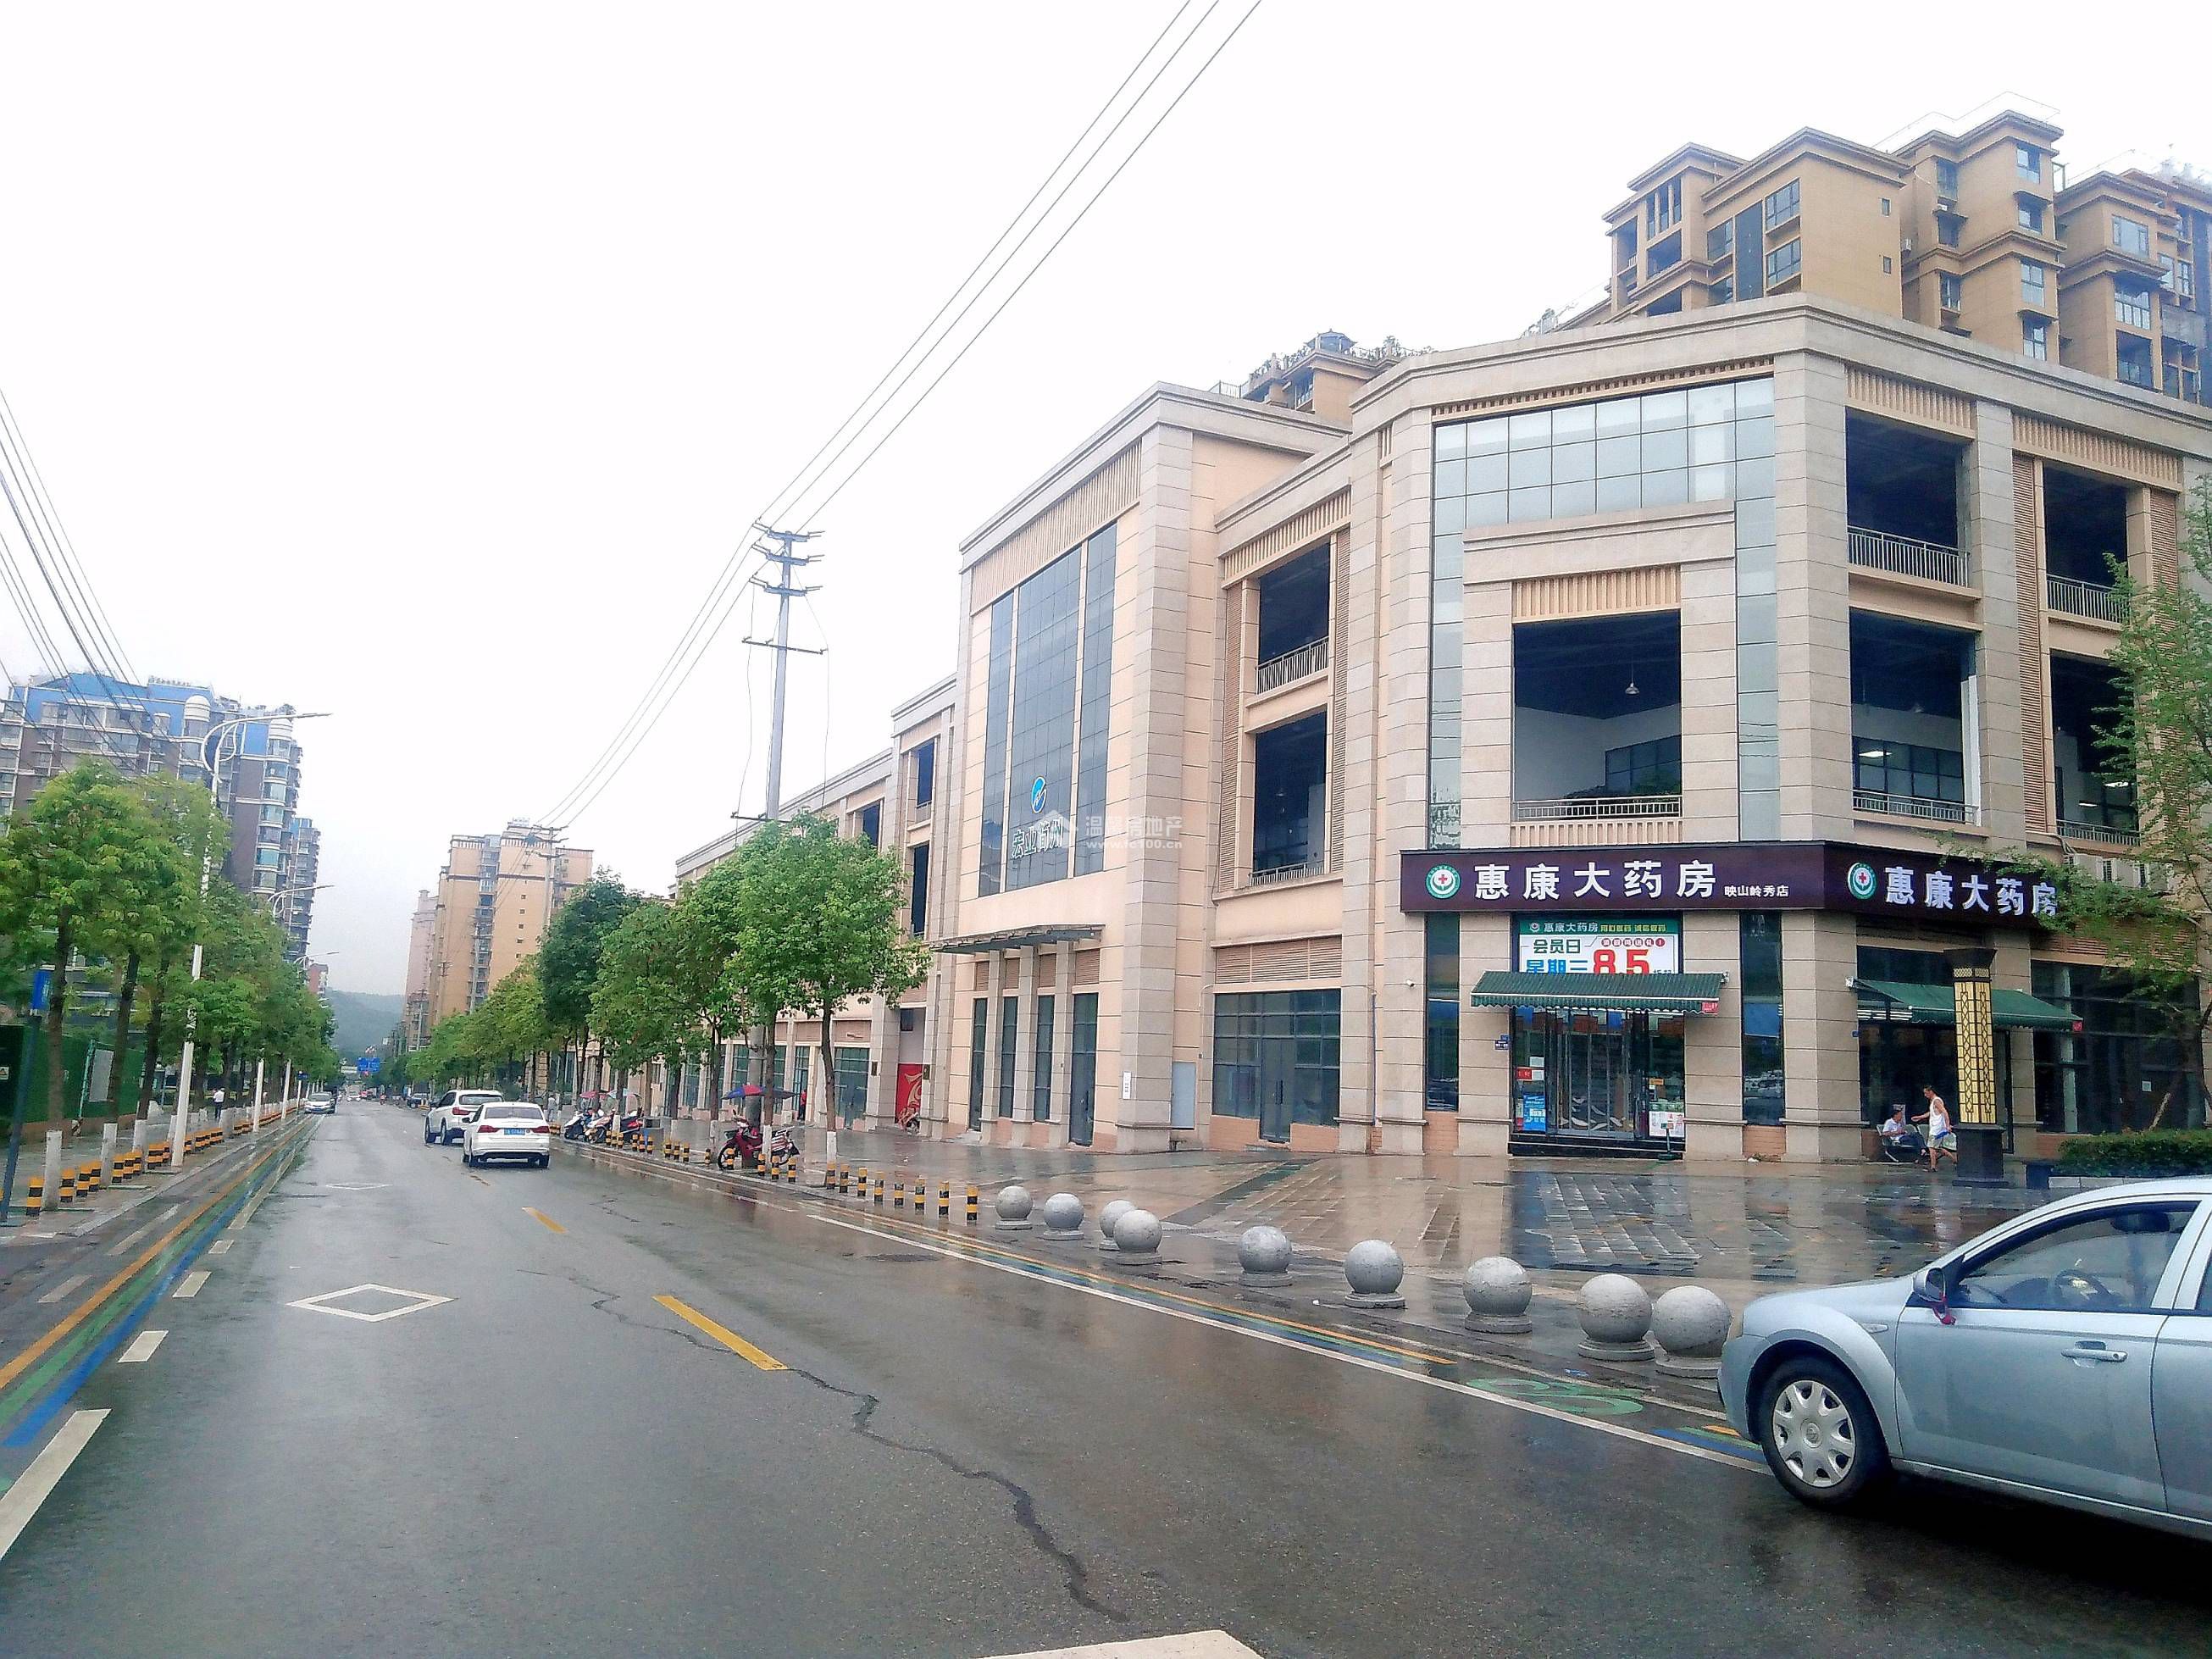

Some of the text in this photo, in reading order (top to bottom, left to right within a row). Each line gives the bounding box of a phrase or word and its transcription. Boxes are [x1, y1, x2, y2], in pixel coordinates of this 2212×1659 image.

[1473, 858, 1717, 901] 惠康大药房
[1723, 885, 1789, 897] 映山岭秀店
[1884, 865, 2059, 917] 惠康大药房
[1544, 922, 1598, 932] 惠康大药房
[1533, 938, 1582, 954] 会员日
